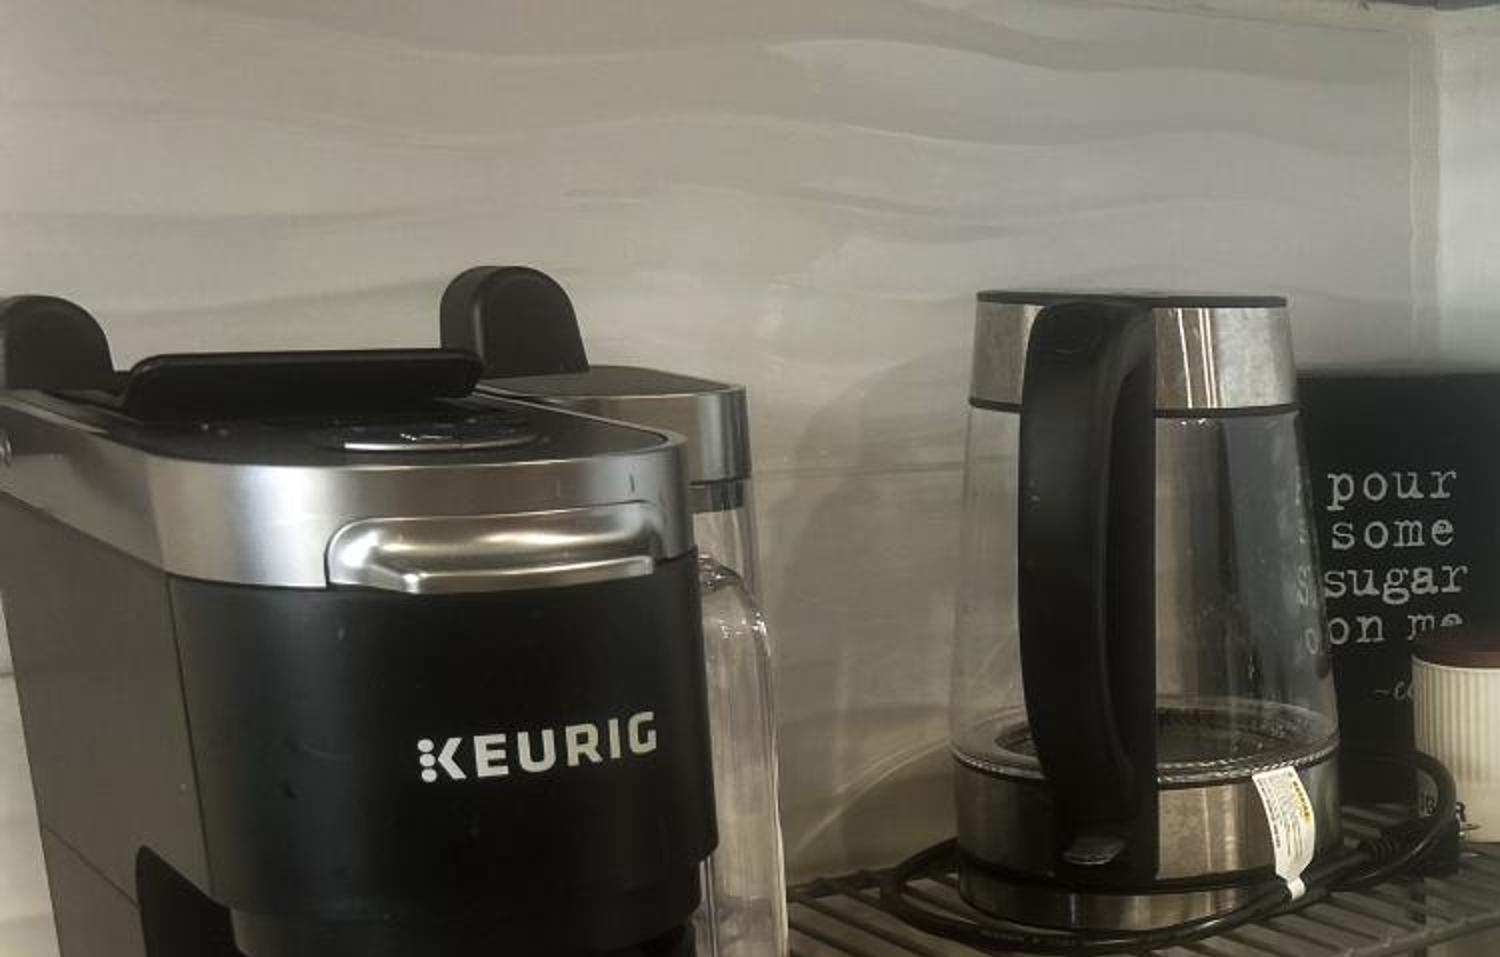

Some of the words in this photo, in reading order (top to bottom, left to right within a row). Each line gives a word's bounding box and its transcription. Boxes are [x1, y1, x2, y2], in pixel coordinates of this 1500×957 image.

[1327, 471, 1457, 511] pour
[1332, 519, 1454, 549] some
[1324, 565, 1468, 604] sugar
[1328, 615, 1385, 645] on
[417, 711, 657, 783] KEURIG
